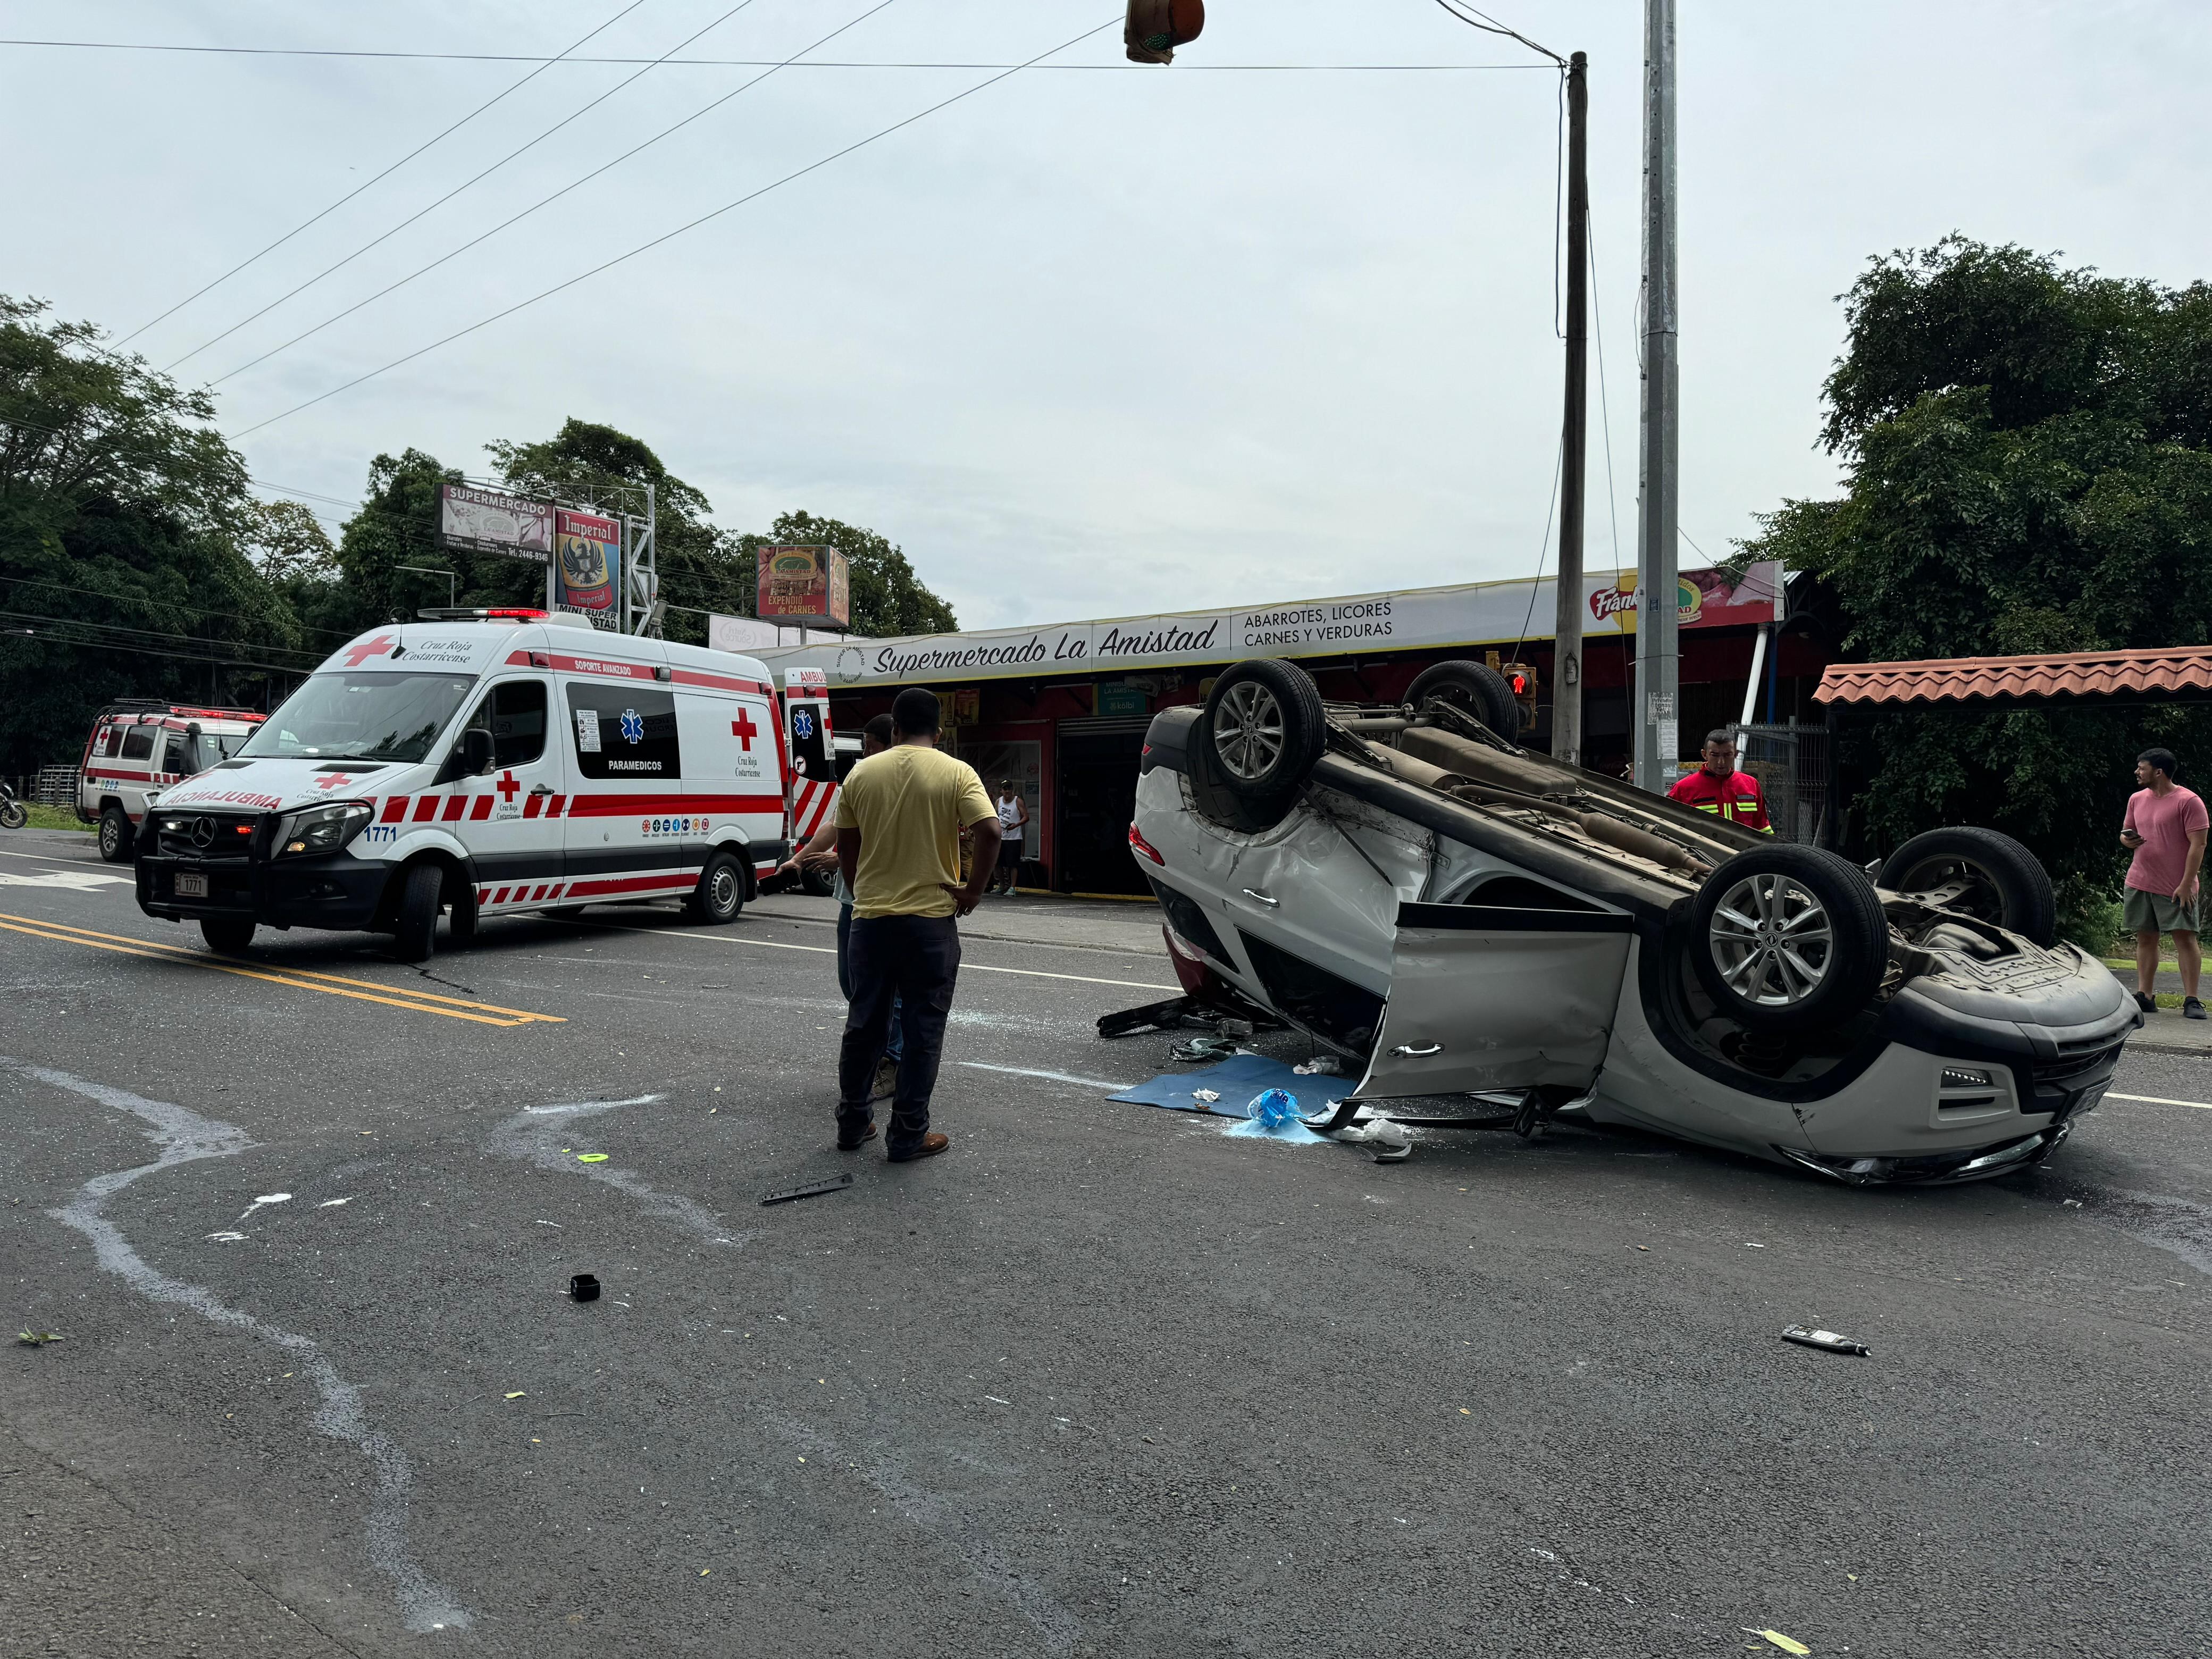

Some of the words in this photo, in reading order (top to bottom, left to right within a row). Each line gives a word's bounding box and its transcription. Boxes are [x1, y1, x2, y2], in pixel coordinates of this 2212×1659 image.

[450, 488, 546, 515] SUPERMERCADO
[564, 515, 611, 543] Imperial
[519, 549, 548, 562] 2446-9346
[577, 590, 606, 608] Imperial
[768, 596, 803, 605] EXPENDIO
[559, 604, 582, 615] MINI
[585, 608, 616, 619] SUPER
[789, 605, 816, 614] CARNES
[1244, 609, 1326, 628] ABARROTES,
[1332, 602, 1392, 620] LICORES
[587, 616, 617, 629] ISTAD
[1245, 630, 1299, 646] CARNES
[1303, 629, 1312, 641] Y
[1317, 622, 1392, 640] VERDURAS
[421, 641, 447, 650] Cruz
[447, 641, 472, 652] Roja
[873, 635, 1046, 679] Supermercado
[1054, 632, 1087, 660] La
[1098, 619, 1218, 656] Amistad
[403, 651, 471, 663] Costarricense
[836, 649, 845, 667] SUPER
[852, 646, 865, 666] AMISTAD
[574, 660, 601, 672] SOPORTE
[602, 665, 631, 676] AVANZADO
[608, 760, 662, 770] PARAMEDICOS
[738, 756, 748, 766] Cruz
[748, 757, 757, 768] Roja
[735, 767, 760, 777] Costarricense
[320, 790, 334, 799] Roja
[364, 826, 396, 842] 1771
[185, 879, 201, 892] 1771
